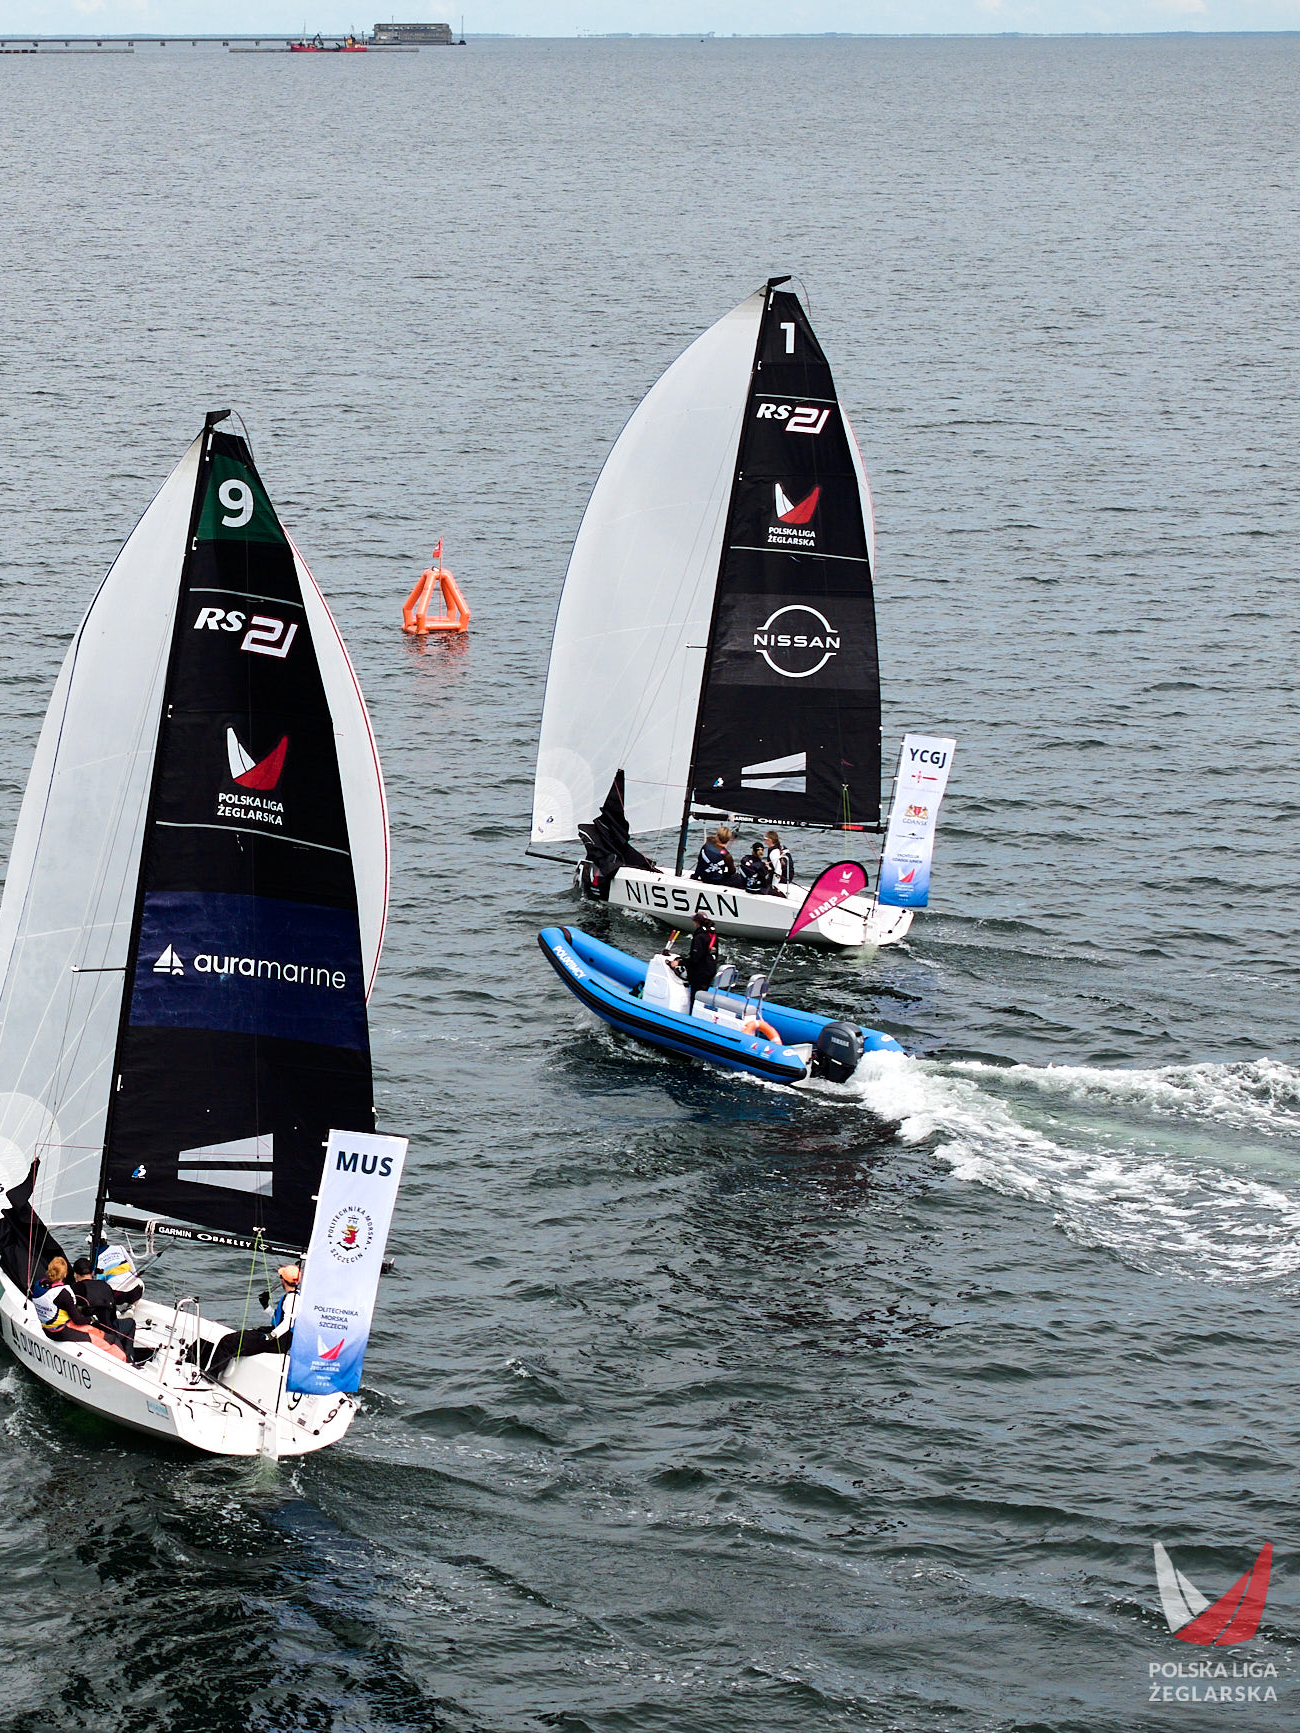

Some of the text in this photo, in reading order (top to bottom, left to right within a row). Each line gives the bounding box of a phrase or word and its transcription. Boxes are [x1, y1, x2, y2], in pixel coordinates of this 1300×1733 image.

[780, 321, 796, 354] 1
[755, 403, 830, 435] RS21
[218, 478, 254, 528] 9
[767, 533, 815, 547] ŻEGLARSKA
[768, 526, 816, 538] POLSKA LIGA
[193, 607, 299, 659] RS21
[753, 633, 840, 650] NISSAN
[909, 747, 947, 769] YCGJ
[218, 792, 284, 813] POLSKA LIGA
[216, 804, 283, 826] ŻEGLARSKA
[625, 879, 739, 918] NISSAN
[808, 888, 850, 919] UMP 1
[193, 952, 346, 989] auramarine
[336, 1150, 394, 1177] MUS
[158, 1226, 192, 1238] GARMIN
[328, 1206, 374, 1245] POLITECHNIKA MORSKA
[330, 1248, 363, 1263] SZCZECIN
[313, 1305, 359, 1317] POLITECHNIKA
[321, 1314, 348, 1323] MORSKA
[318, 1321, 348, 1331] SZCZECIN
[322, 1408, 338, 1424] 9
